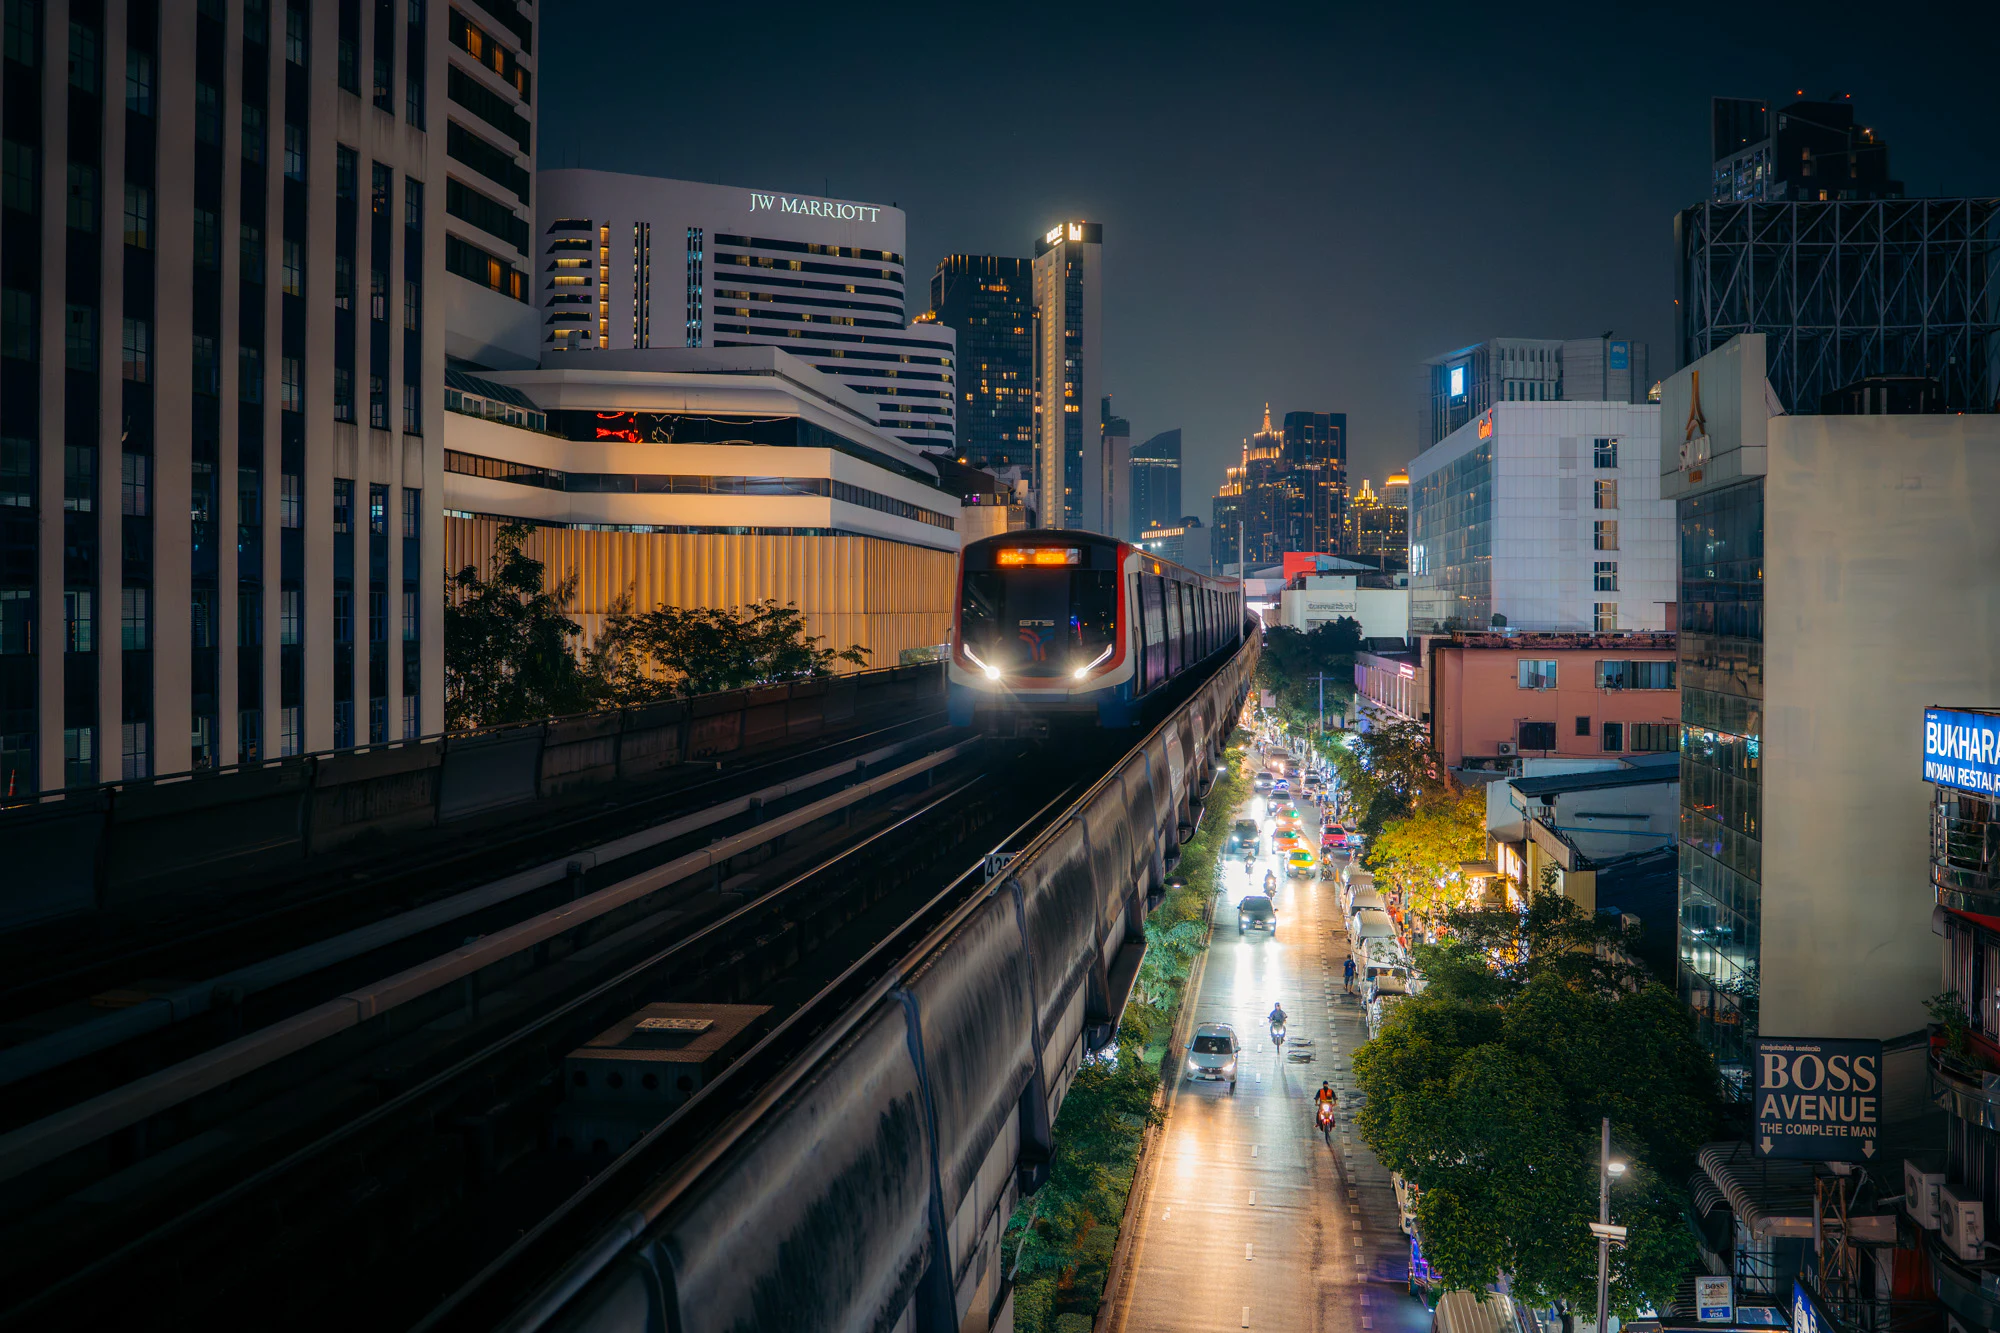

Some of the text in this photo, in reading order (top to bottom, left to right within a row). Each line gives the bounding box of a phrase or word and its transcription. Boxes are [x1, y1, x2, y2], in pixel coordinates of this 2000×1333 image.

[749, 193, 880, 222] JW MARRIOTT
[1760, 1053, 1877, 1092] BOSS
[1760, 1094, 1877, 1122] AVENUE
[1760, 1122, 1877, 1138] THE COMPLETE MAN
